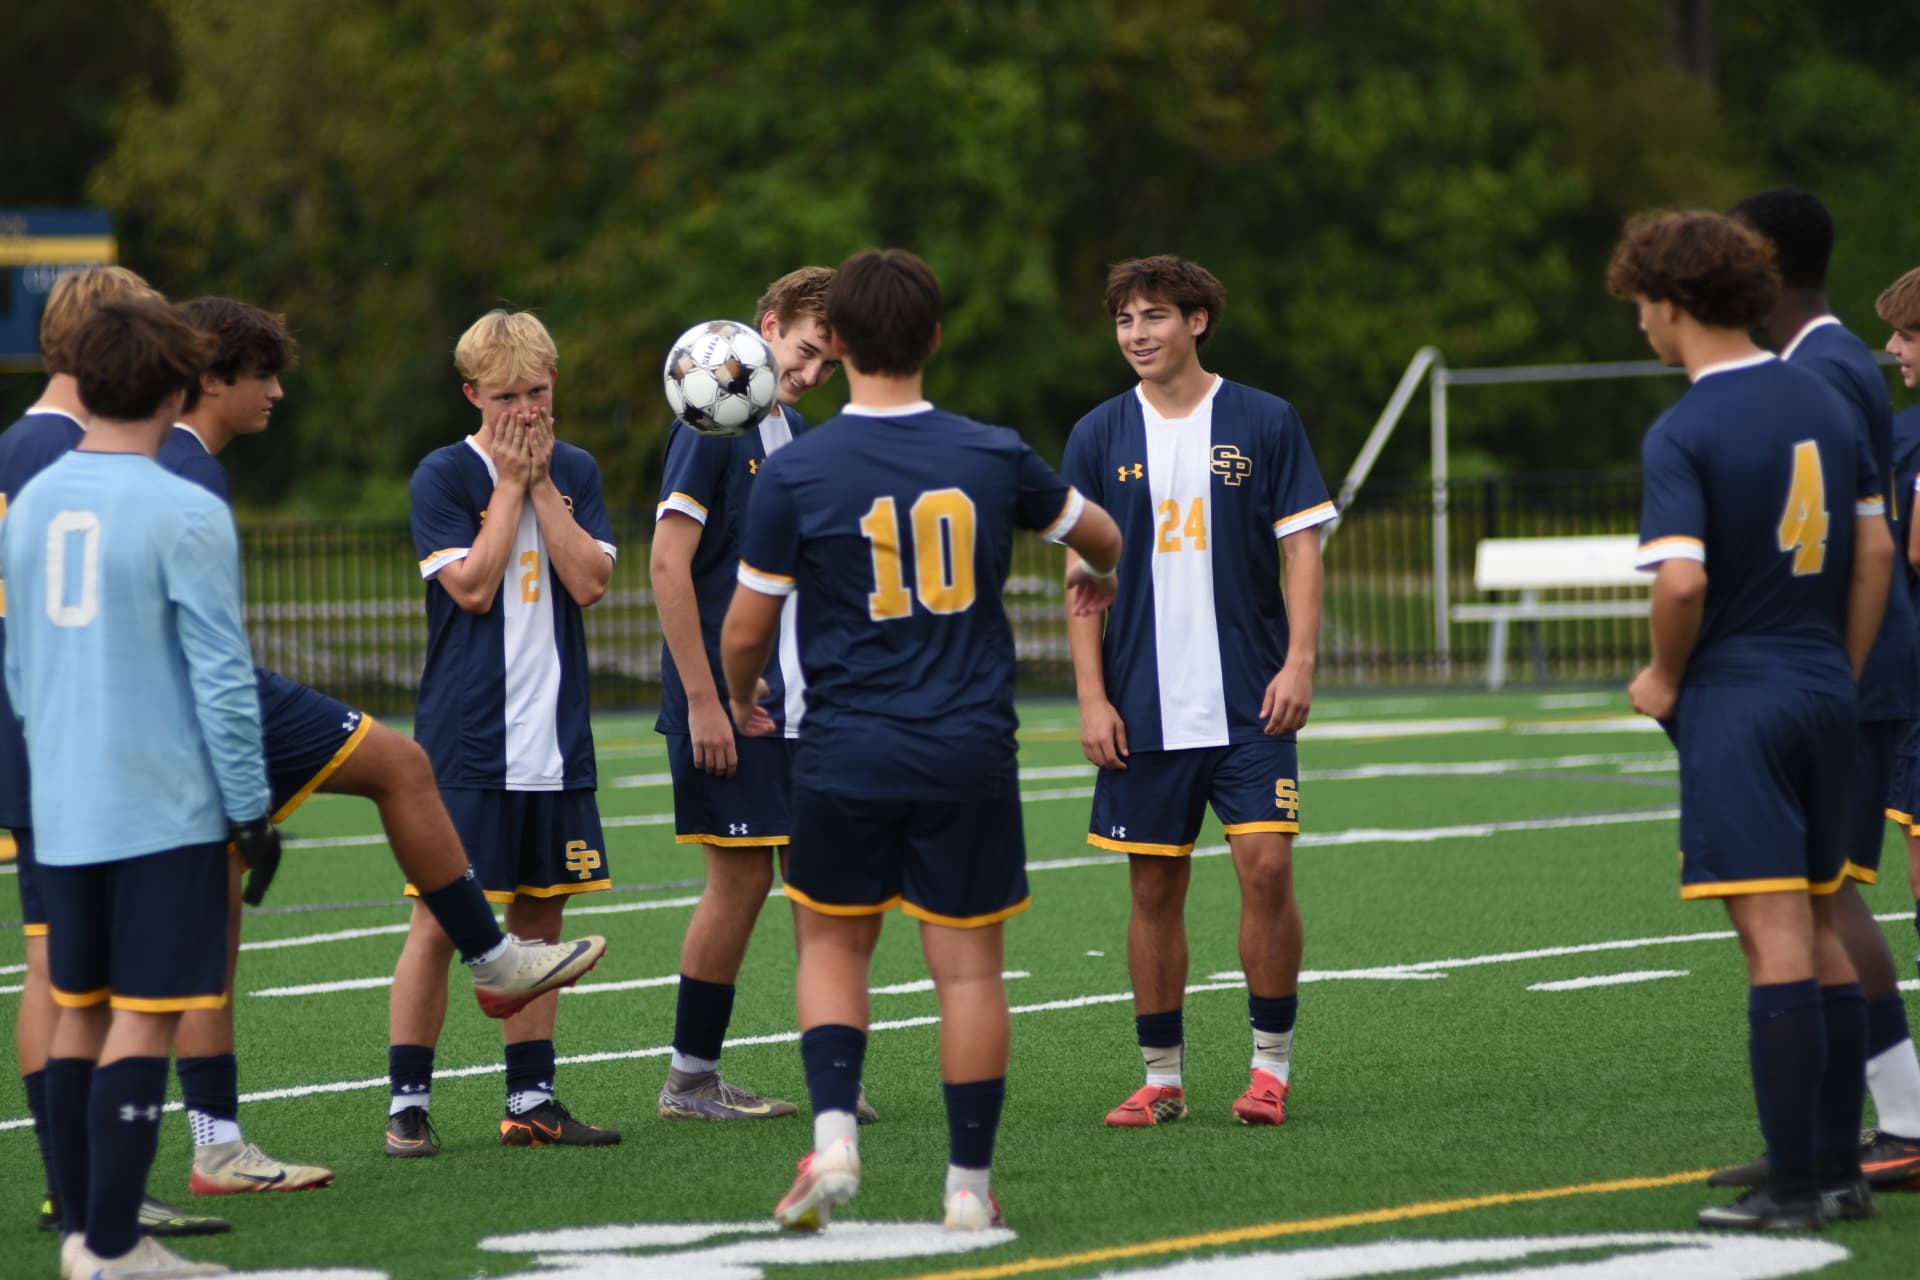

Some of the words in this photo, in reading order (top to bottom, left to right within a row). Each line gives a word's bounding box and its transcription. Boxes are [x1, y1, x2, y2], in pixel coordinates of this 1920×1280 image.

[1157, 496, 1207, 554] 24
[1778, 439, 1829, 576] 4
[46, 510, 100, 626] 0
[519, 550, 540, 604] 2
[859, 487, 976, 622] 10
[565, 840, 601, 880] SP
